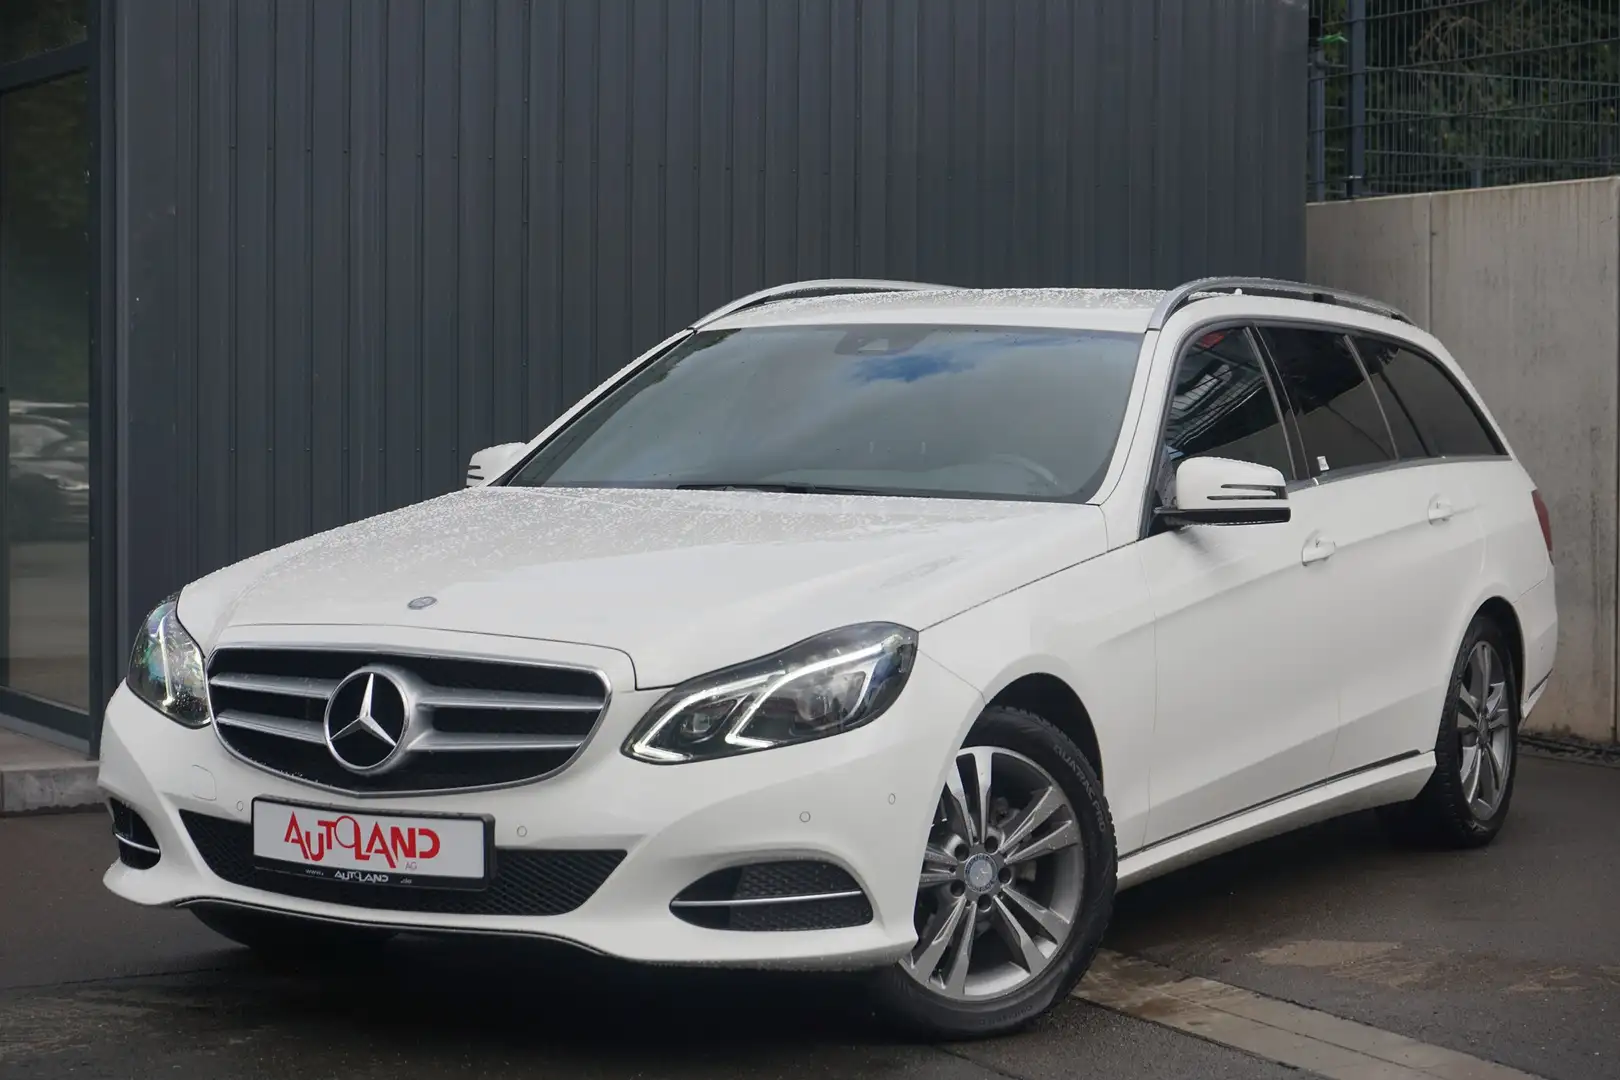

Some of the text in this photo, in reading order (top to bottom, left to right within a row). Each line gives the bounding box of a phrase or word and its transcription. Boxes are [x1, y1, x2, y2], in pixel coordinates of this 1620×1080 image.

[1053, 744, 1106, 832] QUATRAC PRO
[404, 861, 418, 871] AG
